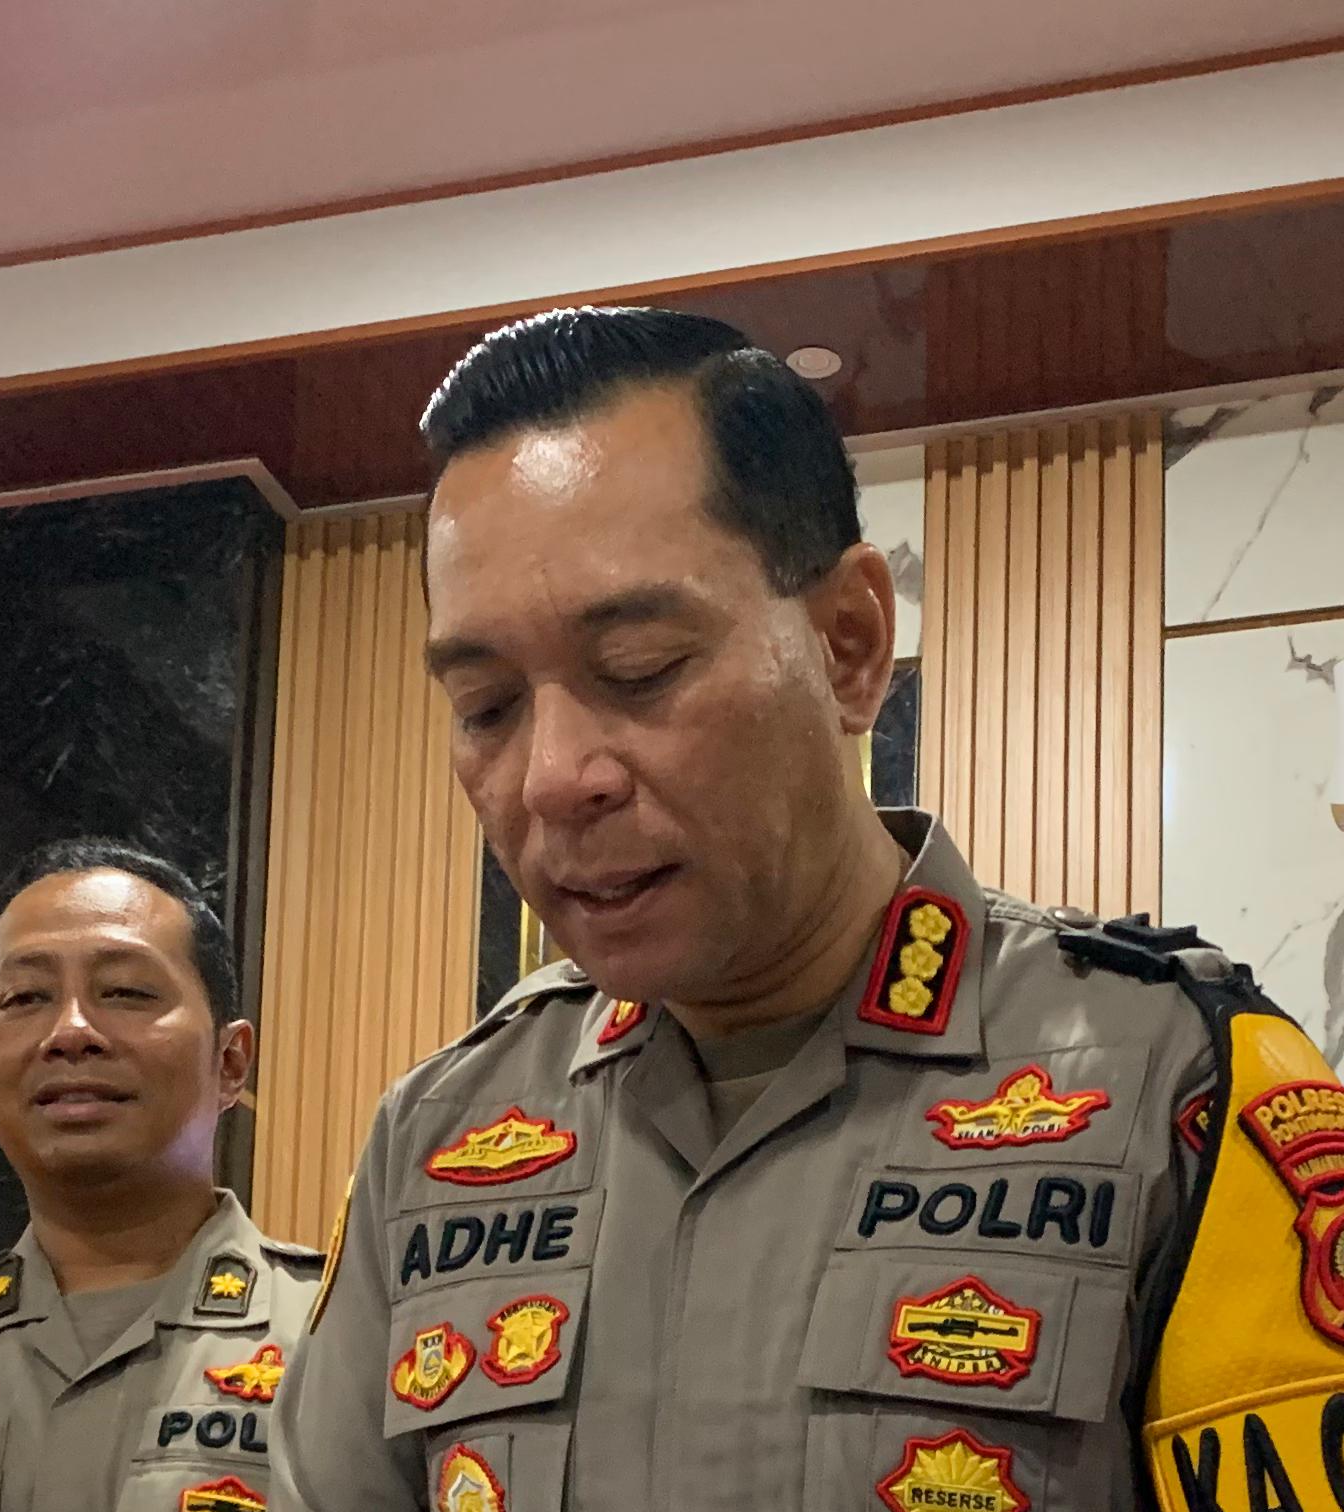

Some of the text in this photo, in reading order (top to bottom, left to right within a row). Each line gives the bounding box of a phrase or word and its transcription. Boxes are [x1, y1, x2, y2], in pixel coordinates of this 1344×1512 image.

[858, 1177, 1114, 1248] POLRI
[401, 1206, 578, 1286] ADHE
[158, 1411, 268, 1453] POL
[912, 1487, 996, 1511] RESERSE
